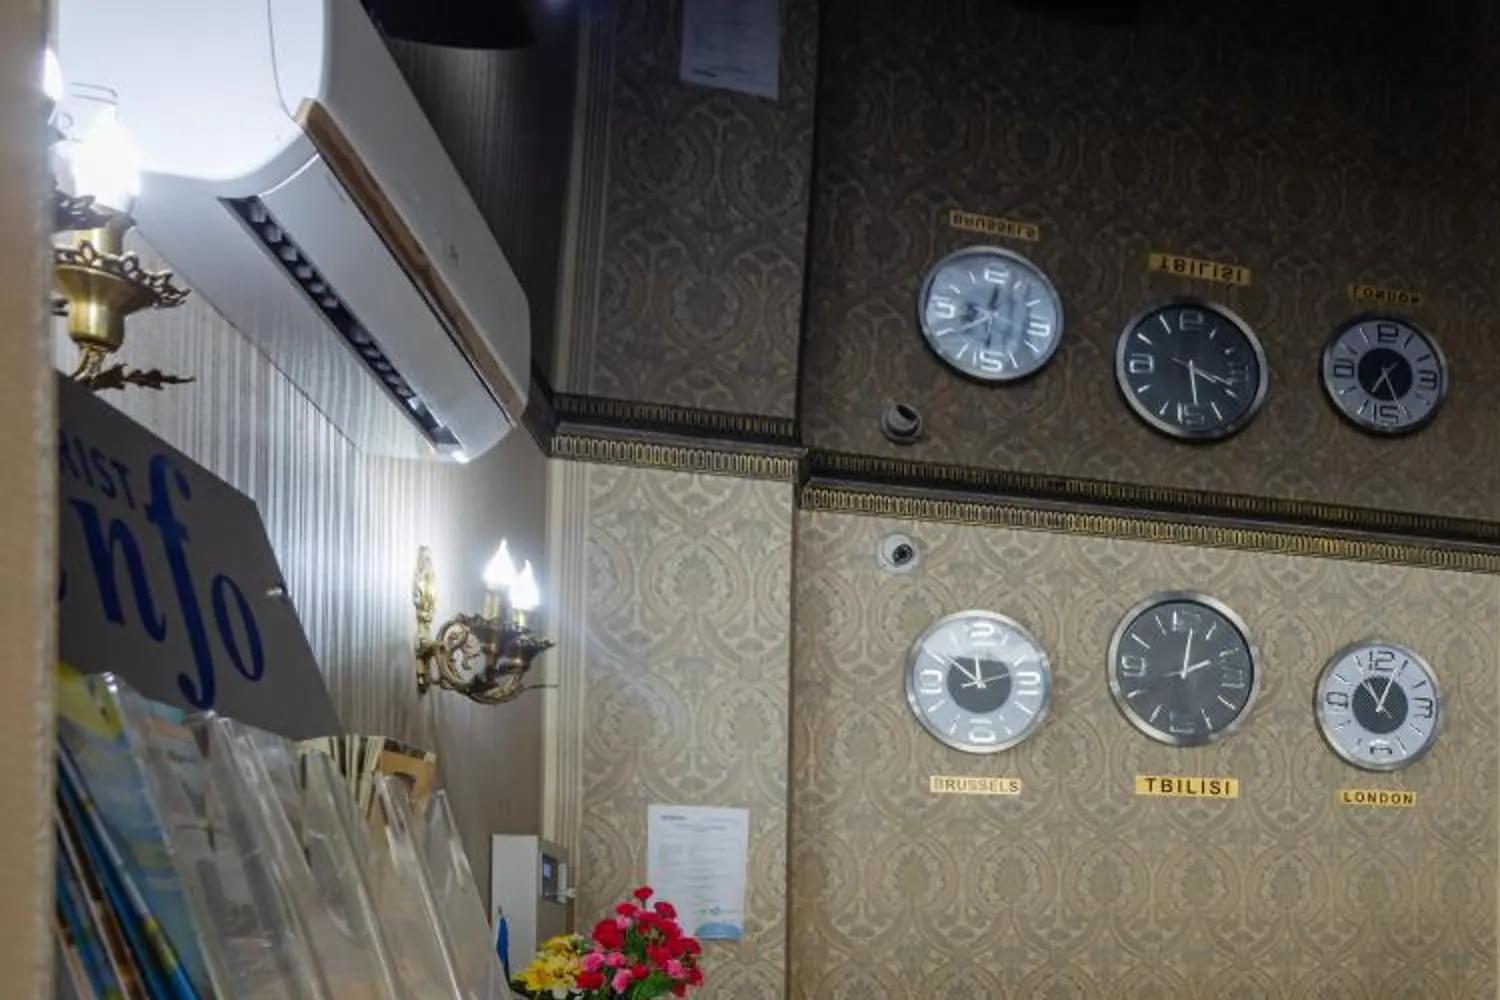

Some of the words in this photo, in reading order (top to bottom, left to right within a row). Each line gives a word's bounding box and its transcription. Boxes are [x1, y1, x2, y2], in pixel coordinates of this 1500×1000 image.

[58, 454, 264, 710] nfo
[1144, 777, 1230, 795] TBILISI
[1343, 791, 1413, 804] LONDON
